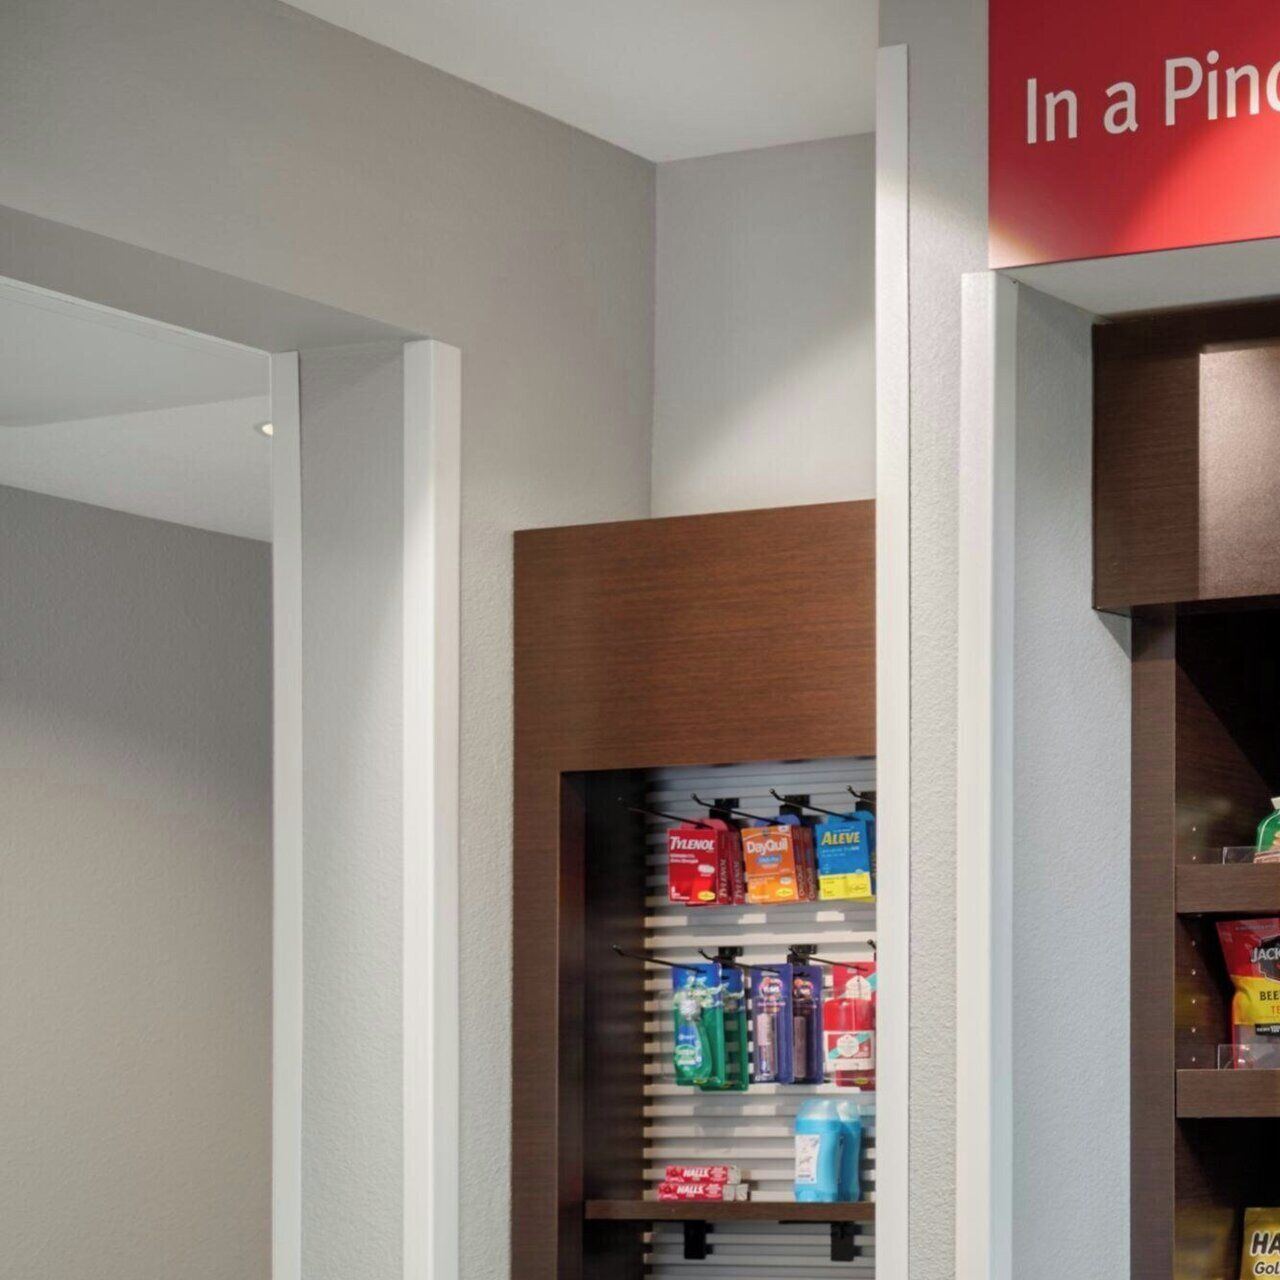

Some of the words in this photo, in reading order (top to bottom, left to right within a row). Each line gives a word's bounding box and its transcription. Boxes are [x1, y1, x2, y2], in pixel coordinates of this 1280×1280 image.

[1027, 78, 1078, 144] In
[1103, 80, 1139, 135] a
[670, 836, 714, 851] TYLENOL
[746, 838, 788, 855] DayQuil
[821, 831, 860, 846] ALEVE
